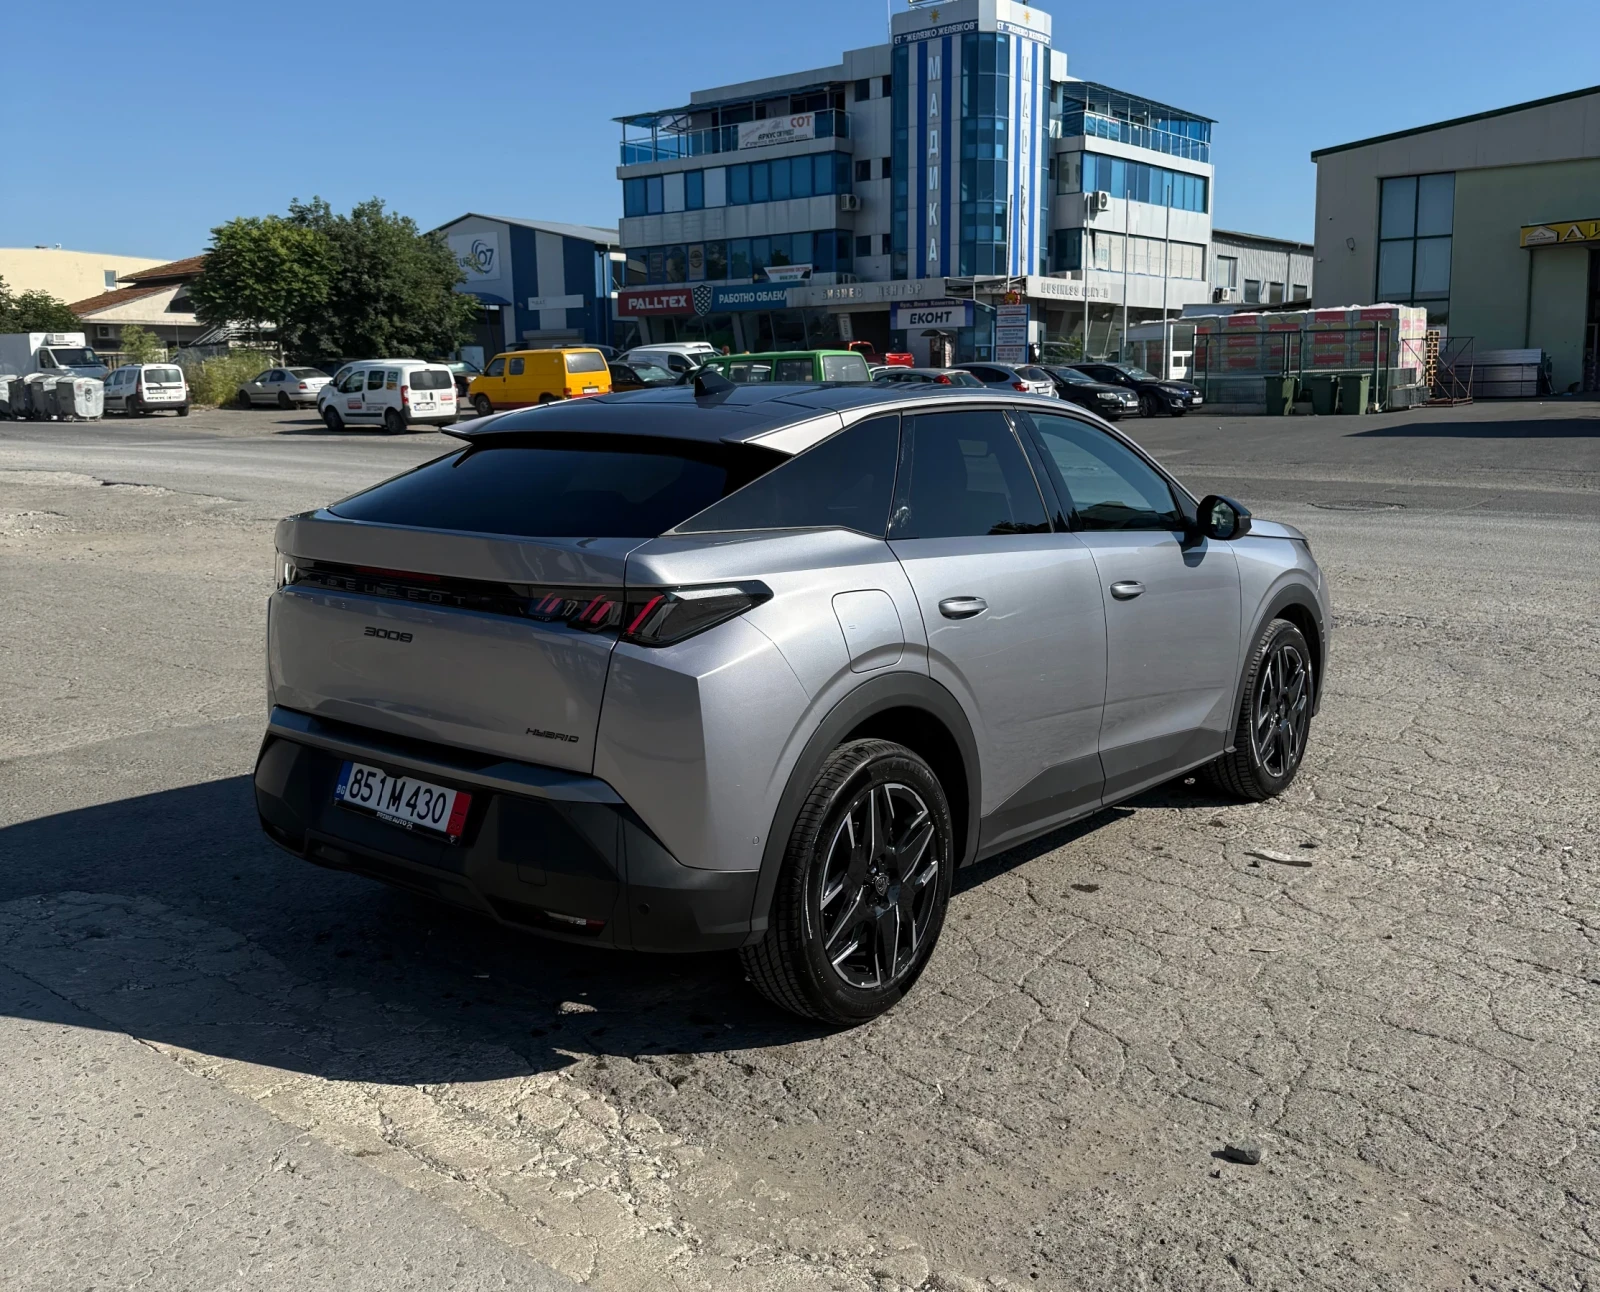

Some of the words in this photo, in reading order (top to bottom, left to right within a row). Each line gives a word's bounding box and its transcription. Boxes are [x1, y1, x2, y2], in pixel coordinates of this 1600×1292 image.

[927, 55, 940, 262] МАДИКА
[628, 295, 687, 310] PALLTEX
[719, 292, 755, 304] РАБОТНО
[909, 311, 952, 325] ЕКОНТ
[326, 578, 466, 605] PEUGEOT
[363, 626, 414, 644] 3008
[525, 727, 580, 743] HYBRID
[336, 783, 347, 795] BG
[392, 815, 407, 827] AUTO
